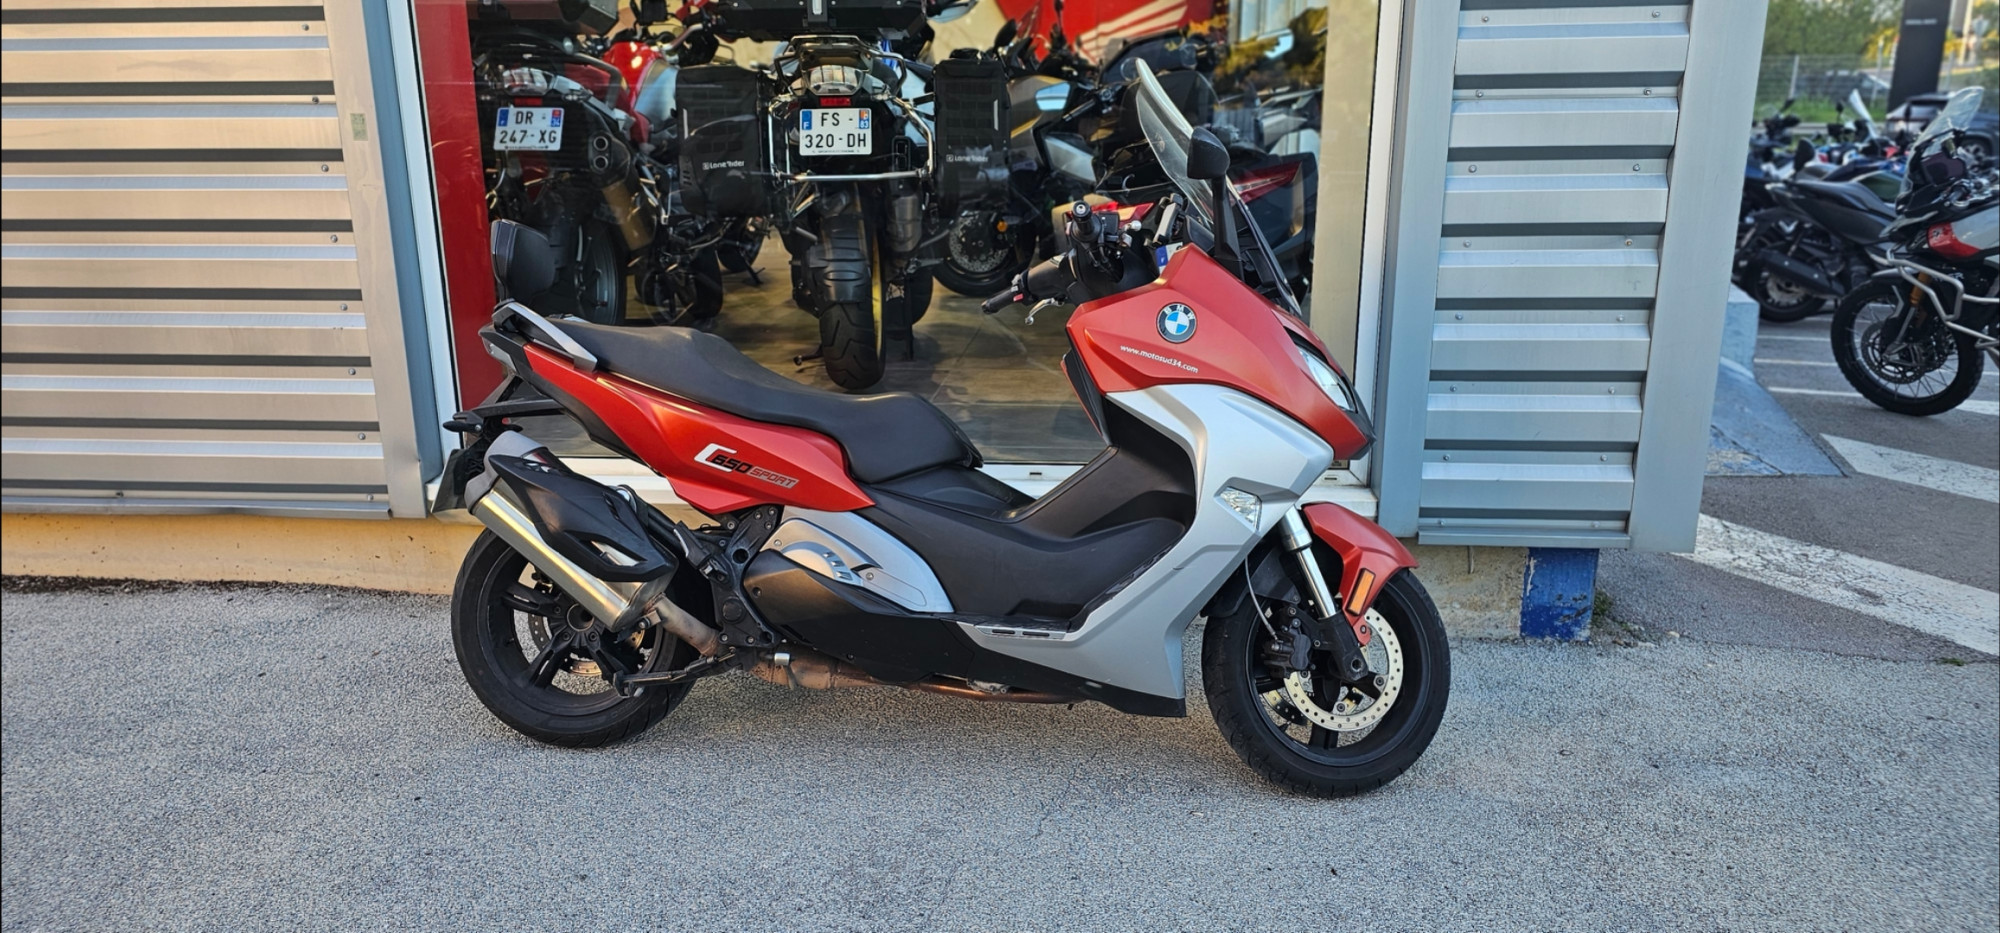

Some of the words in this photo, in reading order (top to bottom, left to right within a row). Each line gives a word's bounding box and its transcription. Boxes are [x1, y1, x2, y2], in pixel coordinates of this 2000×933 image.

[515, 111, 534, 125] DR
[821, 112, 840, 127] FS
[1164, 304, 1195, 320] BMW
[1120, 345, 1199, 374] www.motosud34.com
[750, 467, 796, 487] SPORT
